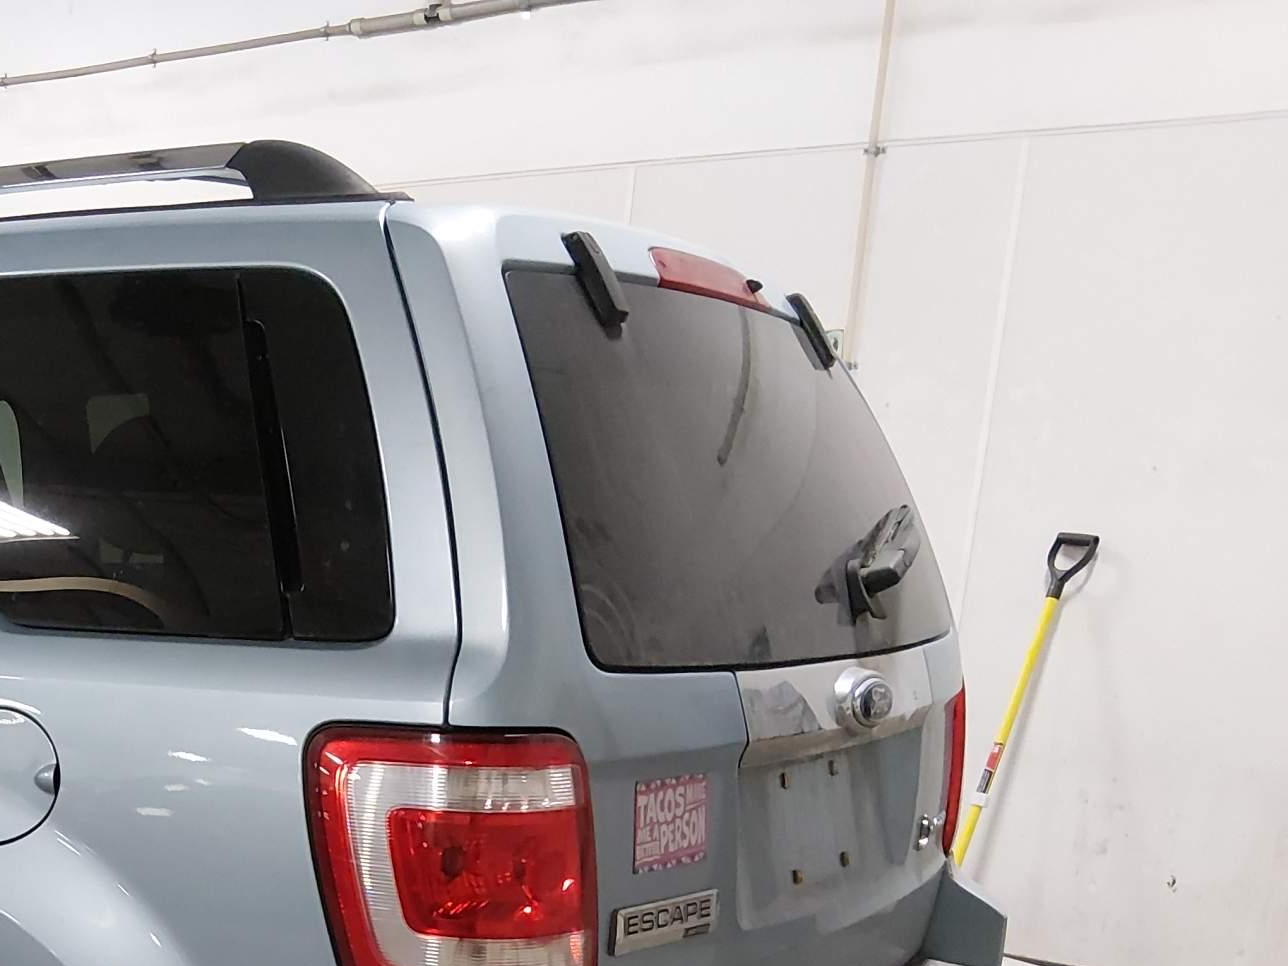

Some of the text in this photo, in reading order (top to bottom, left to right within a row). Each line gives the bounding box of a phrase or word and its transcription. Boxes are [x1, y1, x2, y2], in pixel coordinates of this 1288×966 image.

[637, 786, 685, 828] TACOS
[660, 805, 706, 854] PERSON
[624, 899, 711, 936] ESCAPE
